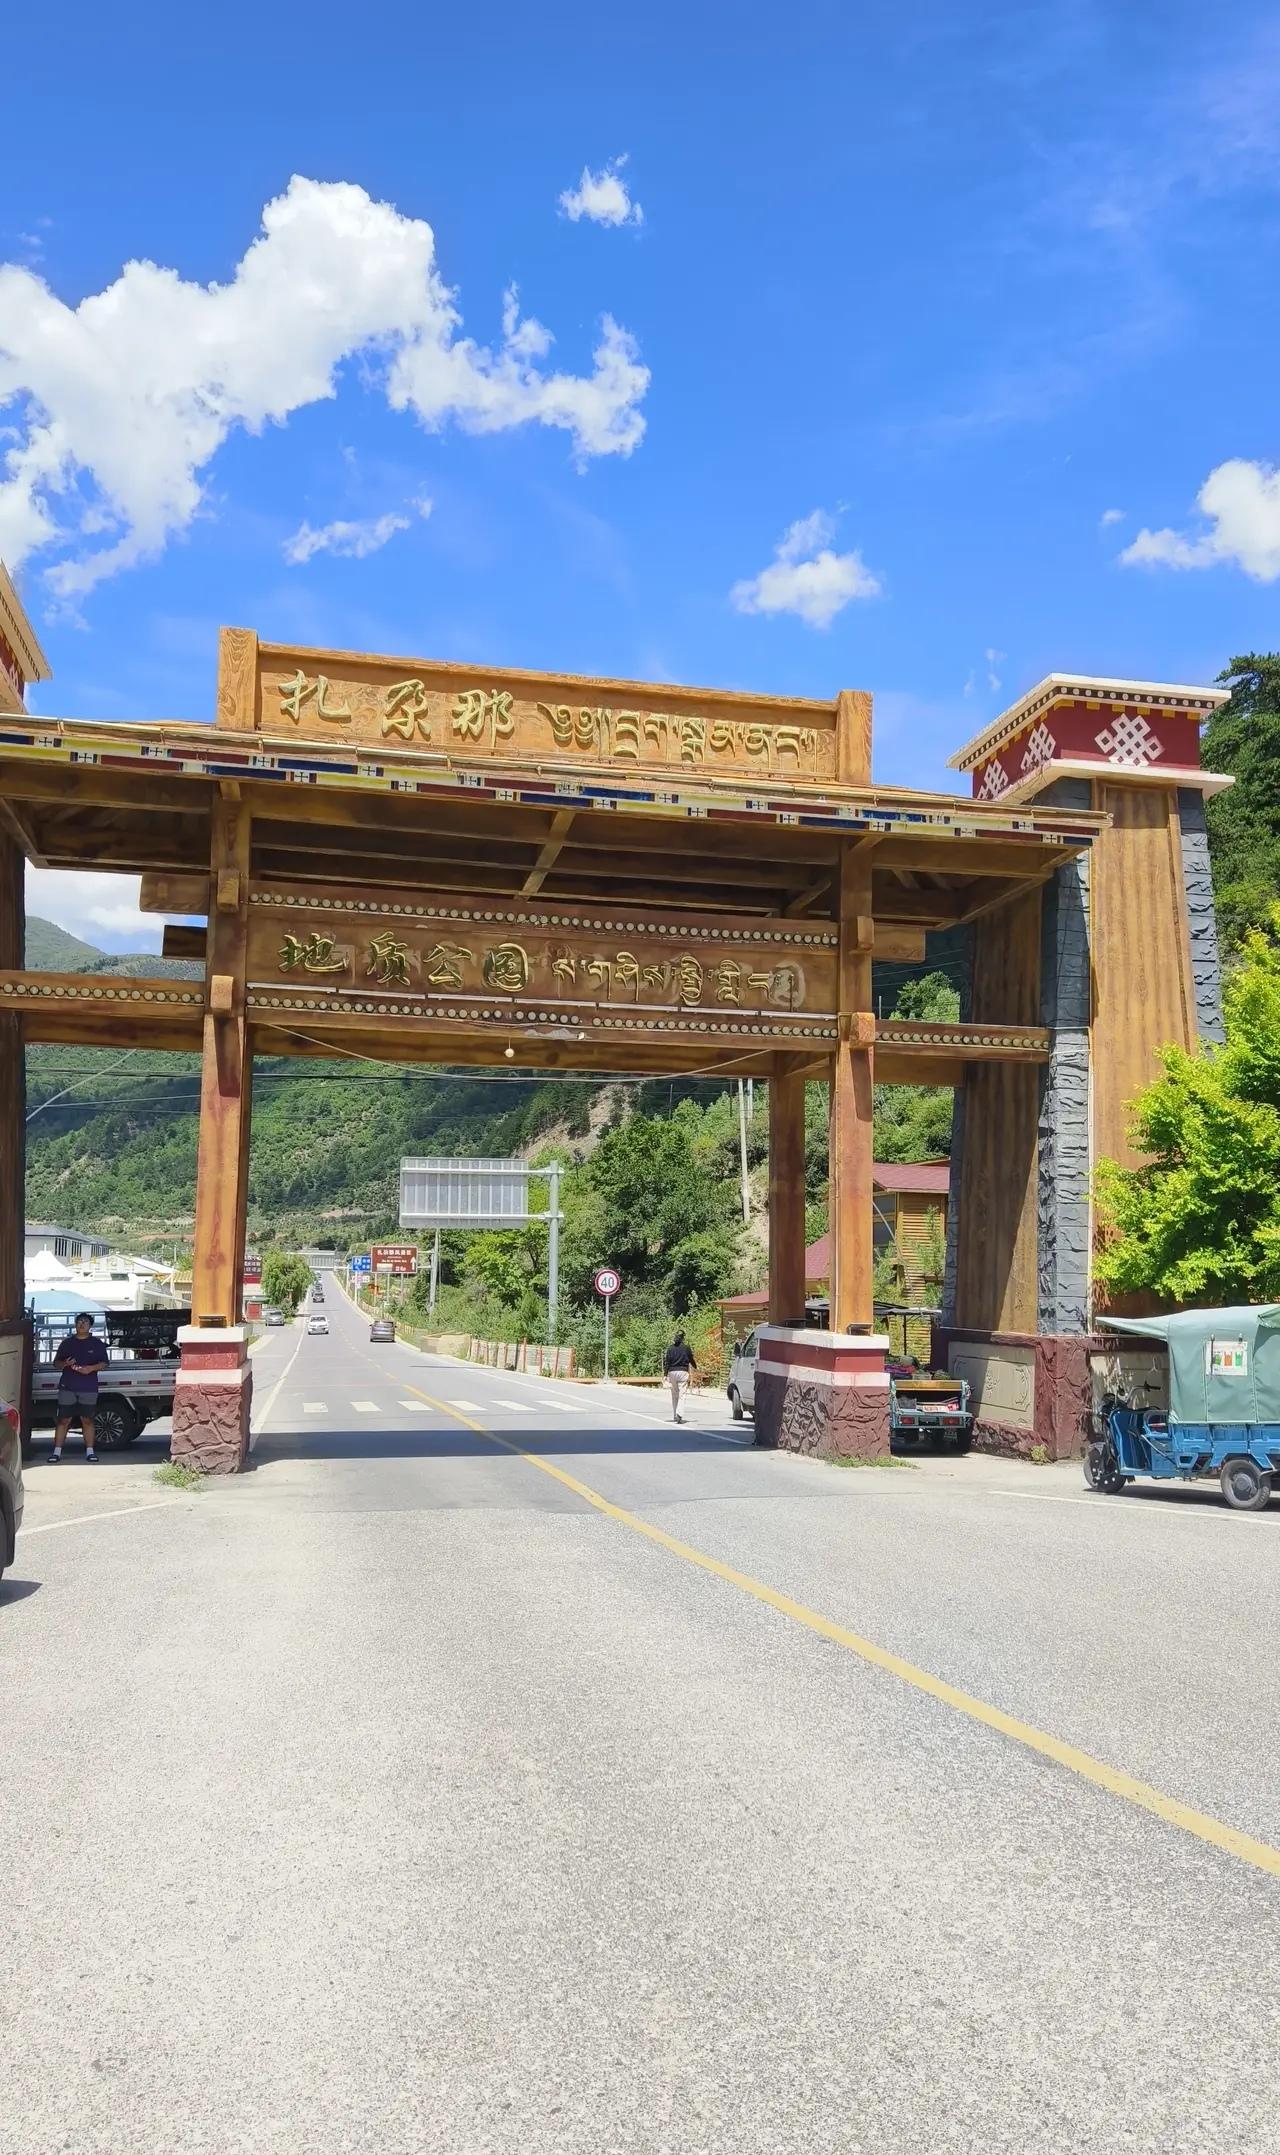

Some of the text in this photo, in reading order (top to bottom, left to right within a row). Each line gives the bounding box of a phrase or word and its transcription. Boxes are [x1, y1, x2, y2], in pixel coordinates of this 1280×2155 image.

[278, 669, 515, 748] 扎尕那
[601, 1276, 615, 1288] 40
